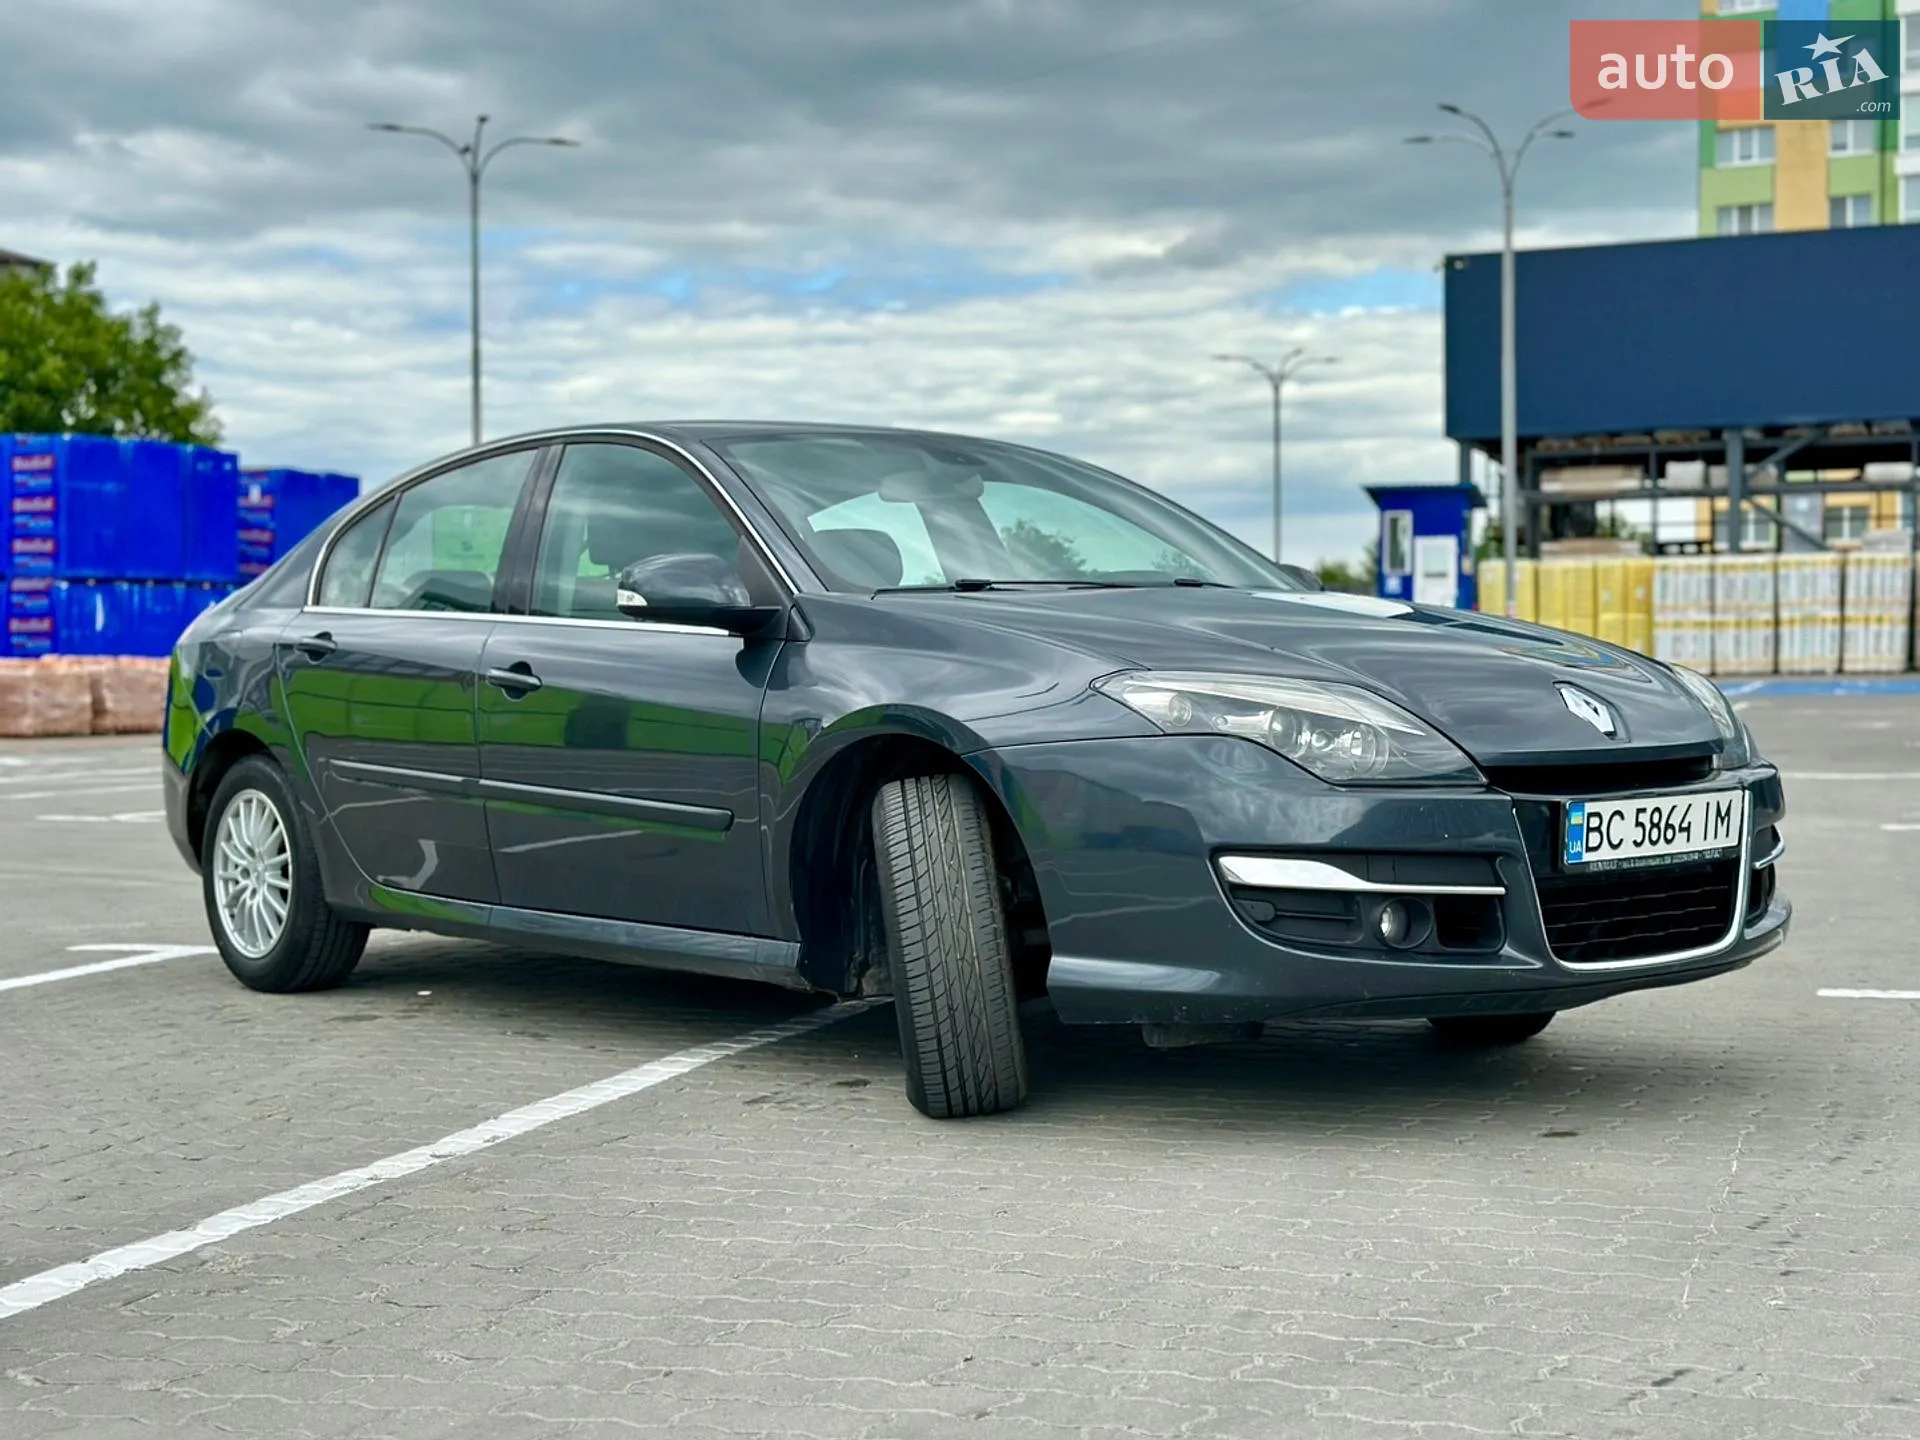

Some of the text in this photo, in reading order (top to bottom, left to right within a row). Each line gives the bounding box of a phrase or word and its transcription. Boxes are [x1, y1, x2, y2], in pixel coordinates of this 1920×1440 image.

[1585, 799, 1733, 853] BC 5864 IM
[1569, 840, 1582, 854] UA
